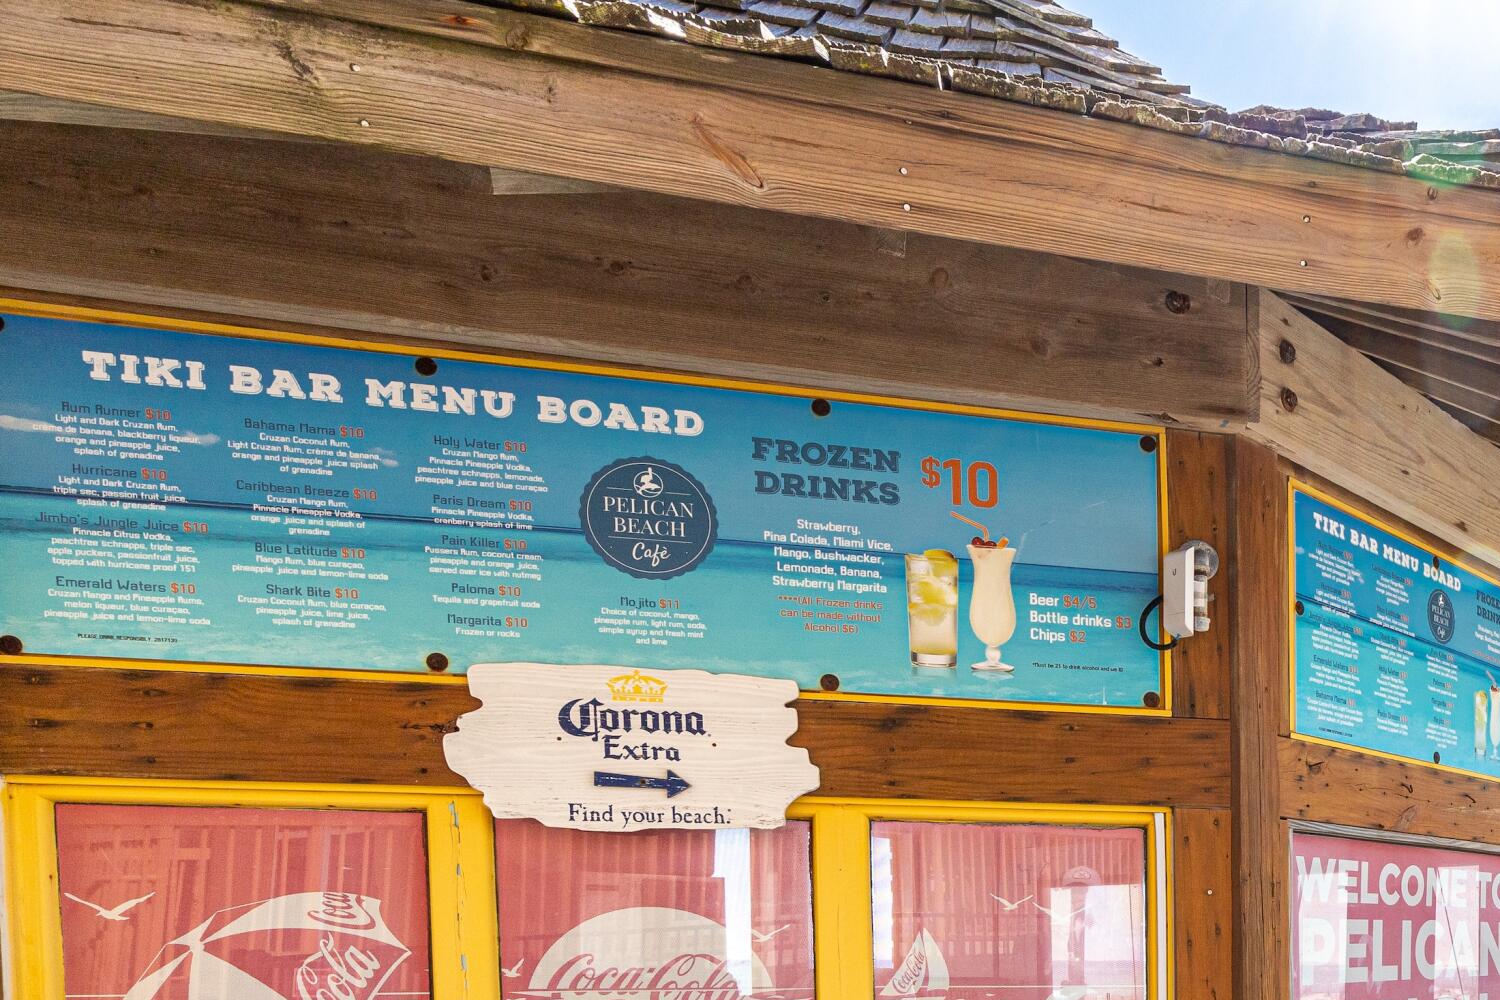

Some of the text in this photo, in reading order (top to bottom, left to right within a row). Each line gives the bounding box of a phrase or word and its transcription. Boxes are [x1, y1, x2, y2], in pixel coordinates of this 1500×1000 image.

[82, 350, 705, 437] TIKI BAR MENU BOARD
[62, 401, 171, 421] Rum Runner $10
[55, 414, 77, 424] Light
[80, 416, 97, 425] and
[99, 418, 120, 427] Dark
[123, 420, 154, 430] Cruzan
[244, 418, 364, 438] Bahama Mama $10
[433, 435, 527, 452] Holy Water $10
[752, 436, 901, 473] FROZEN
[72, 464, 167, 481] Hurricane $10
[236, 480, 378, 500] Caribbean Breeze $10
[754, 470, 901, 506] DRINKS
[920, 456, 998, 509] $10
[433, 494, 532, 512] Paris Dream $10
[603, 496, 694, 518] PELICAN
[35, 511, 208, 534] Jimbo's Jungle Juice $10
[614, 517, 686, 537] BEACH
[797, 519, 861, 535] Strawberry,
[441, 535, 527, 550] Pain Killer $10
[764, 531, 787, 542] Pina
[834, 537, 864, 548] Miami
[867, 540, 894, 551] Vice,
[255, 542, 365, 559] Blue Latitude $10
[1313, 512, 1345, 540] TIKI
[1350, 528, 1378, 555] BAR
[1383, 543, 1418, 571] MENU
[1423, 563, 1461, 592] BOARD
[55, 576, 196, 594] Emerald Waters $10
[266, 584, 359, 599] Shark Bite $10
[451, 583, 521, 596] Paloma $10
[773, 576, 887, 595] Strawberry Margarita
[432, 595, 461, 604] Tequila
[480, 599, 518, 607] grapefruit
[620, 596, 680, 609] Mojito $11
[816, 598, 850, 609] Frozen
[854, 599, 883, 610] drinks
[1030, 593, 1097, 609] Beer $4/5
[448, 614, 528, 627] Margarita $10
[780, 609, 881, 623] can be made without
[1030, 611, 1132, 629] Bottle drinks $3
[1432, 605, 1450, 619] PELICAN
[1434, 615, 1449, 627] BEACH
[456, 628, 484, 637] Frozen
[804, 623, 840, 633] Alcohol
[1030, 628, 1087, 644] Chips $2
[558, 698, 707, 741] Corona
[603, 735, 682, 762] Extra
[568, 803, 613, 822] Find
[622, 808, 663, 828] your
[1296, 856, 1468, 908] WELCOME
